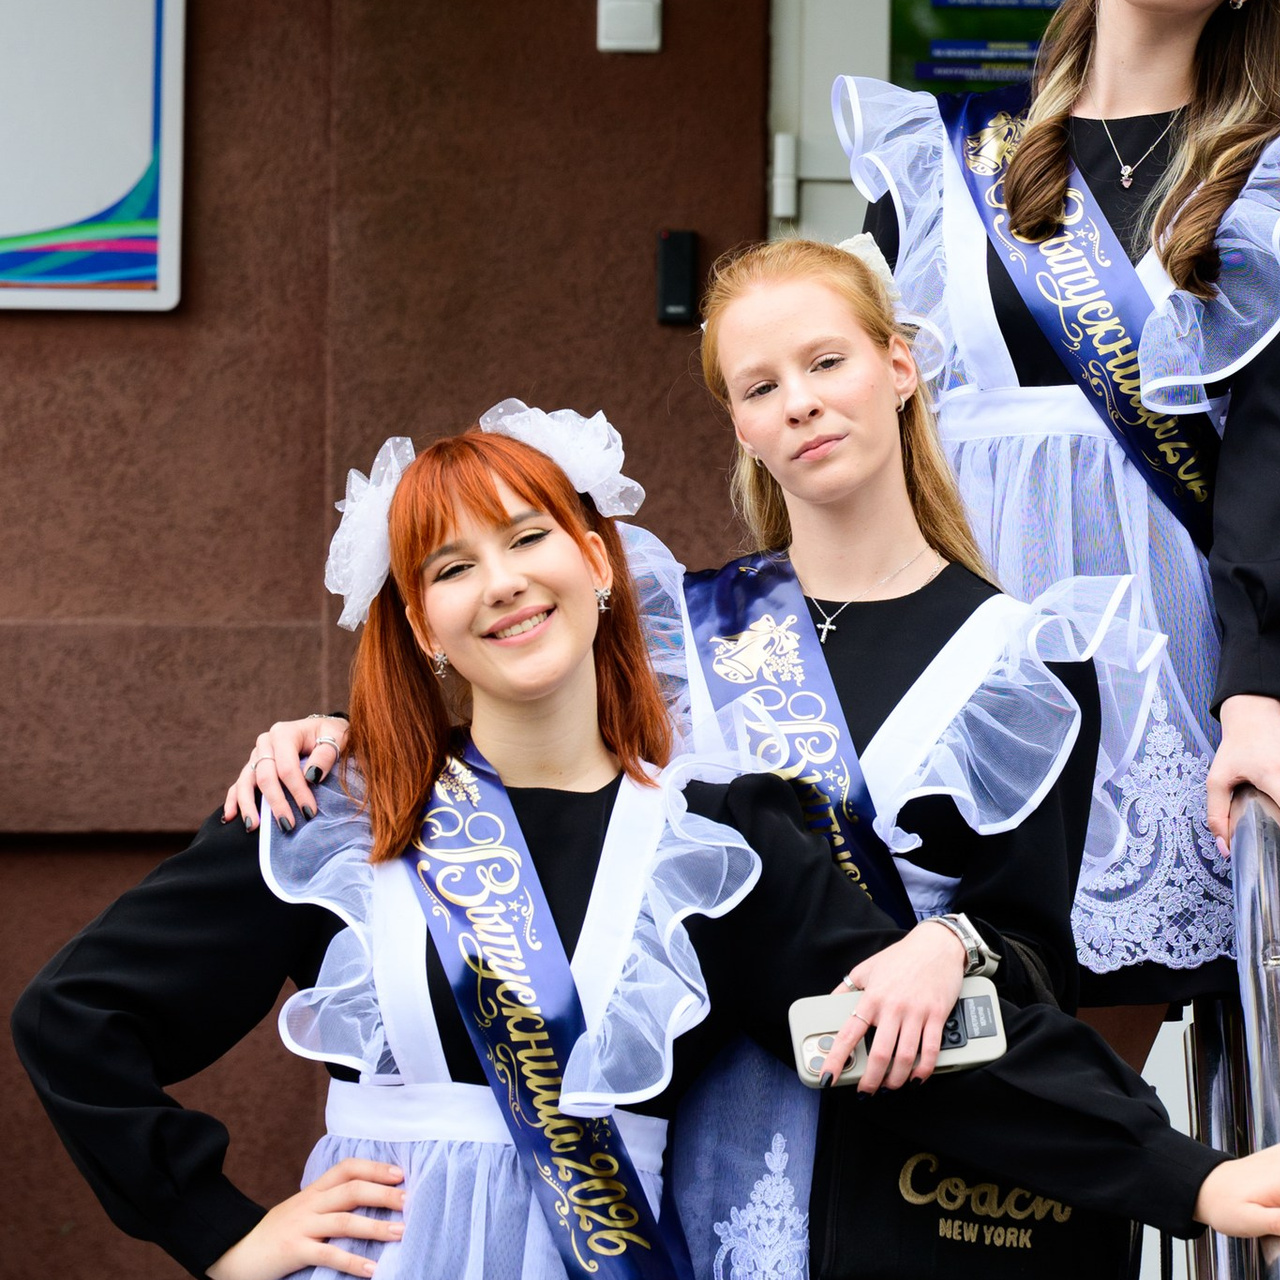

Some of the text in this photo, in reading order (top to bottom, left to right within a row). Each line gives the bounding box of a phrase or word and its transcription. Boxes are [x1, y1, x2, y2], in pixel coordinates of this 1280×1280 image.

[413, 807, 651, 1258] Выпускница 2026
[938, 1217, 1033, 1249] NEW YORK
